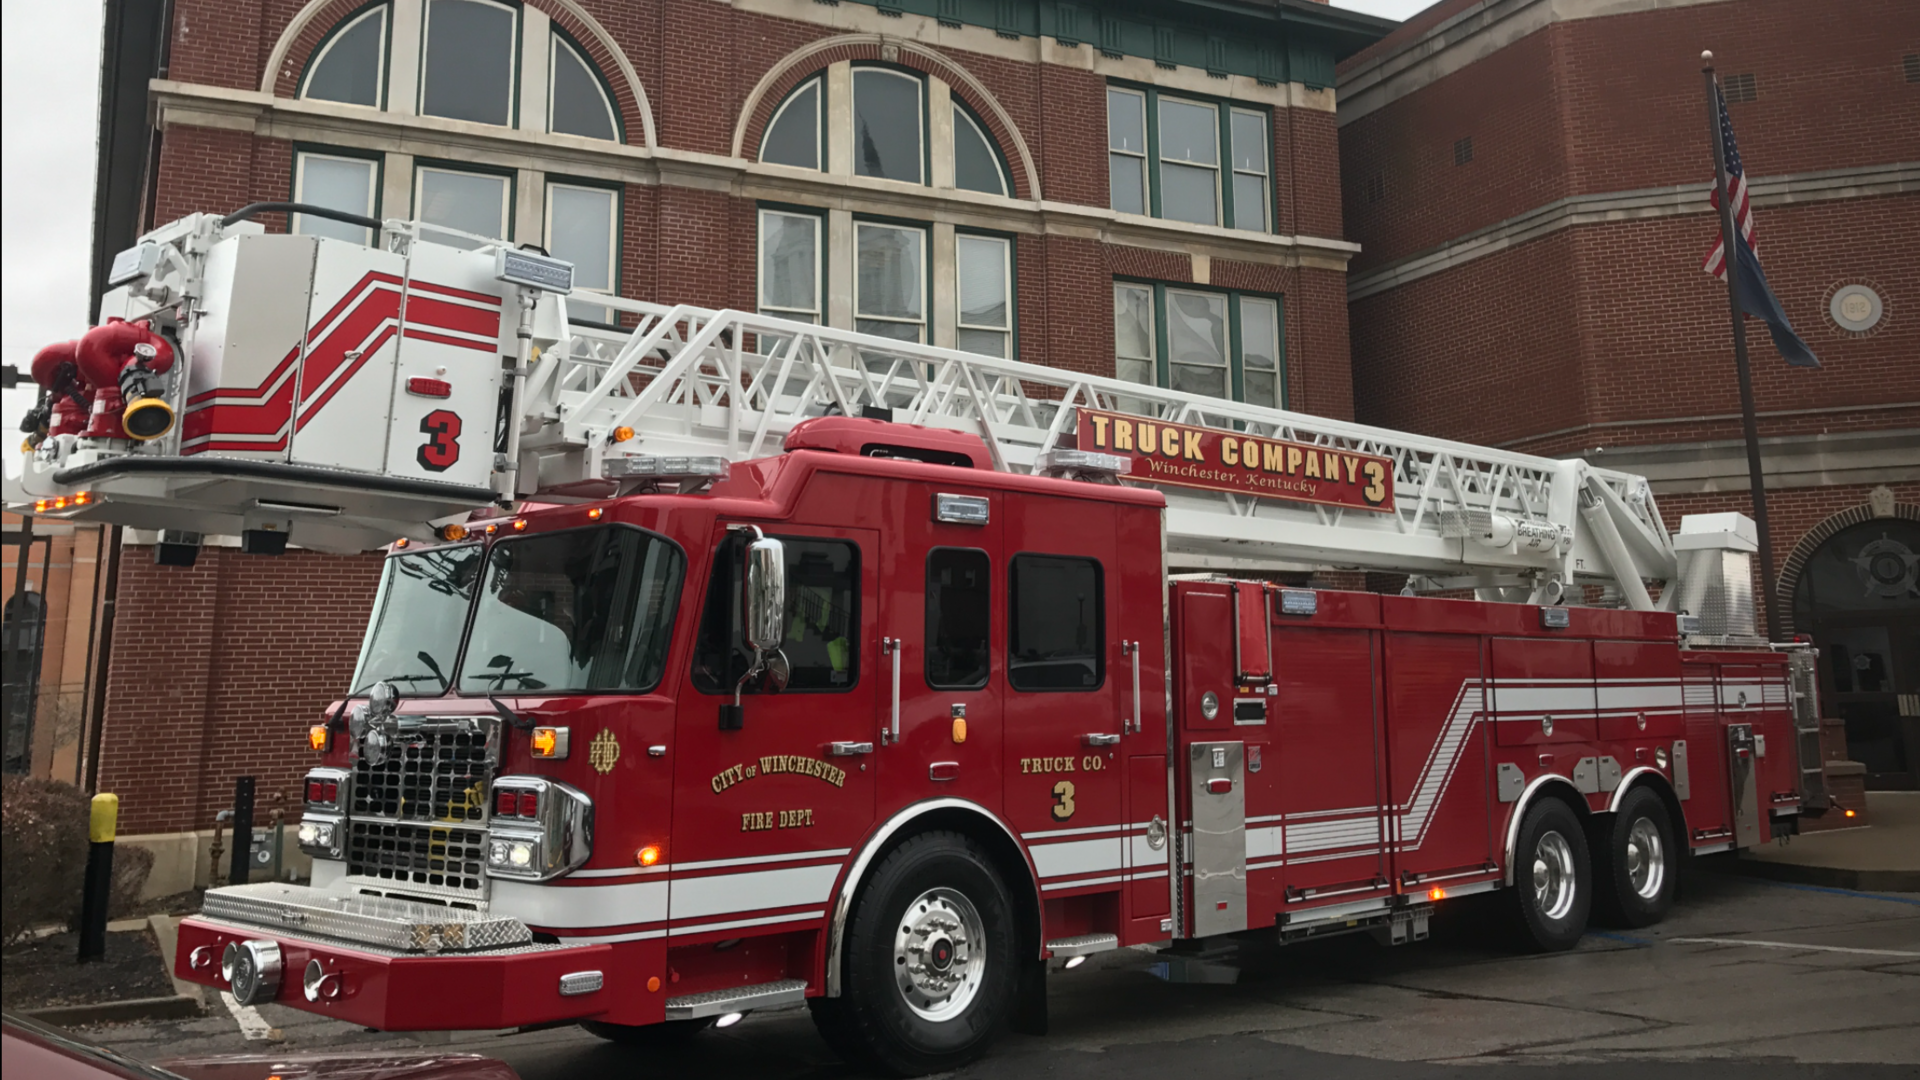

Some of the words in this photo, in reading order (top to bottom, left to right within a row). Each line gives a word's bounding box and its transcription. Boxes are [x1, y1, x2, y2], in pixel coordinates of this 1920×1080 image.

[1844, 302, 1866, 314] 1912
[416, 408, 462, 473] 3
[1091, 415, 1205, 462] TRUCK
[1221, 436, 1359, 486] COMPANY
[1363, 461, 1386, 506] 3
[1145, 458, 1239, 485] Winchester,
[1246, 473, 1317, 497] Kentucky
[1518, 527, 1555, 540] BREATHING
[1527, 539, 1542, 547] AIR
[1576, 559, 1586, 569] FT.
[711, 763, 743, 794] CITY
[758, 755, 847, 788] WINCHESTER
[1020, 756, 1075, 774] TRUCK
[1082, 755, 1106, 771] CO.
[1051, 780, 1075, 822] 3
[741, 812, 773, 832] FIRE
[778, 809, 815, 829] DEPT.
